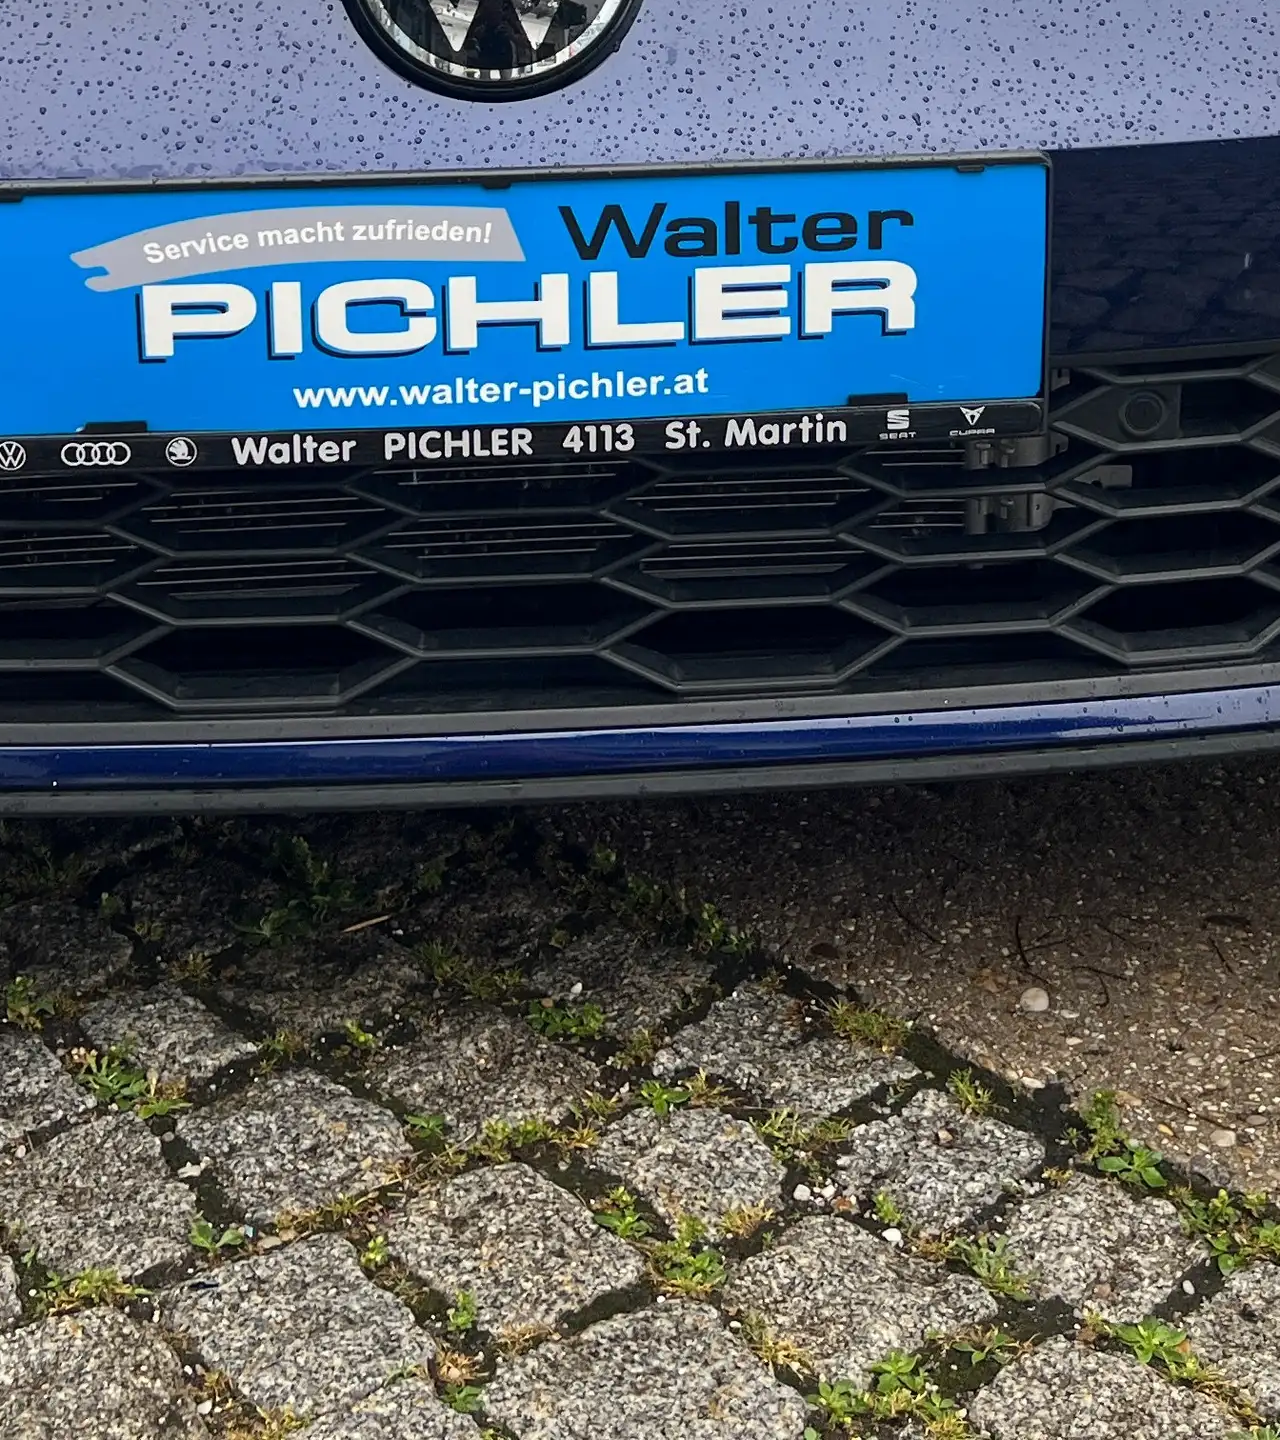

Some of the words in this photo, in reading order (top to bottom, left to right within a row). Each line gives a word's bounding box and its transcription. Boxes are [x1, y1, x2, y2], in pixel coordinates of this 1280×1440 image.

[143, 230, 249, 264] Service
[257, 221, 345, 247] macht
[352, 219, 493, 243] zufrieden!
[558, 200, 915, 261] Walter
[138, 259, 919, 362] PICHLER
[293, 369, 708, 411] www.walter-pichler.at
[231, 433, 357, 465] Walter
[384, 427, 534, 460] PICHLER
[562, 424, 636, 453] 4113
[664, 421, 711, 450] St.
[724, 413, 847, 448] Martin
[879, 431, 917, 441] SEAT
[949, 428, 996, 437] CUPRA
